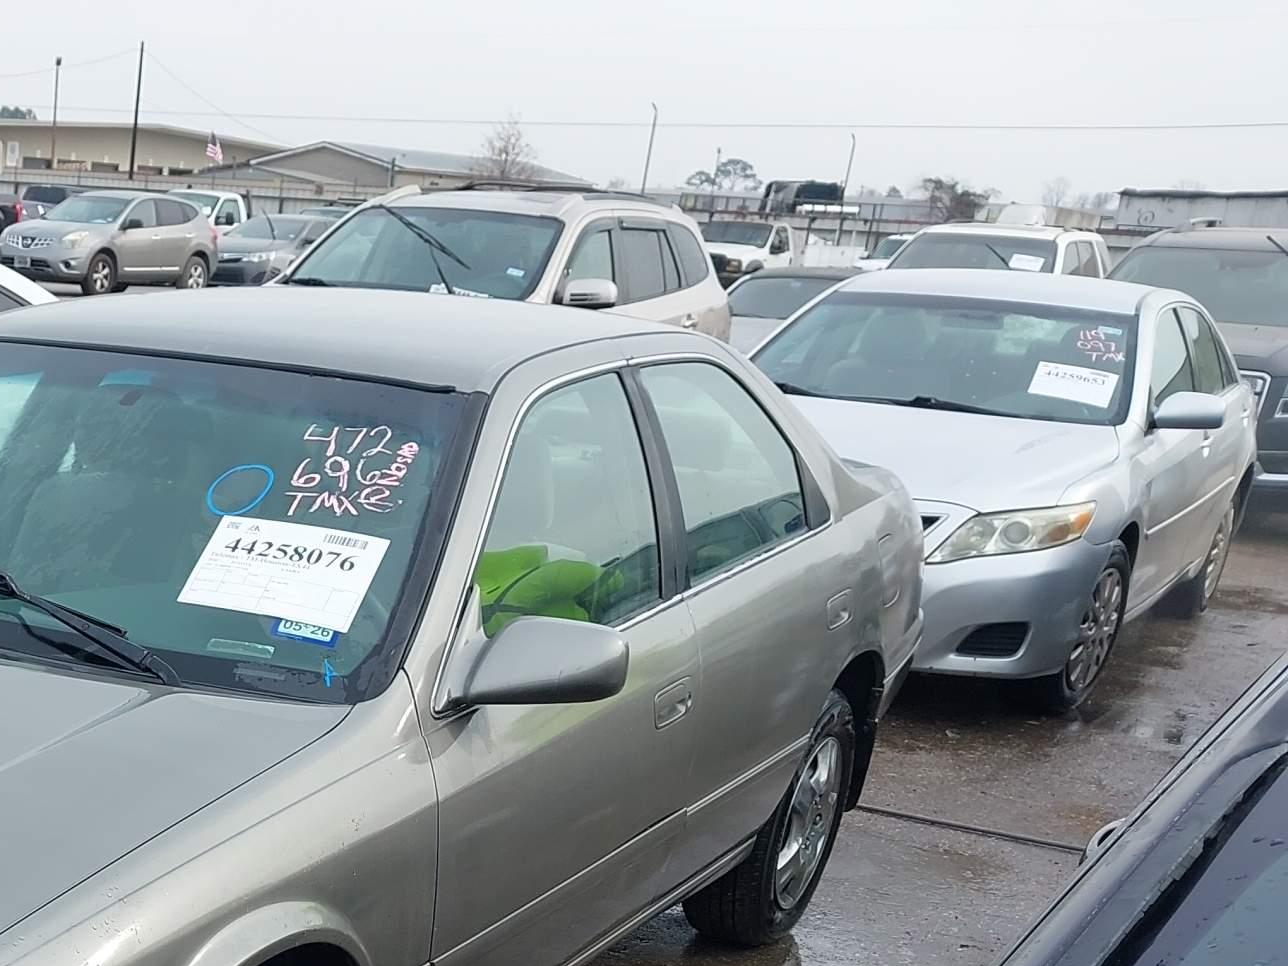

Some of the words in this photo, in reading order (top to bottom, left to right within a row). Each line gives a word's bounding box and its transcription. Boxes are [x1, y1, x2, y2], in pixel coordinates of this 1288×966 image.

[303, 424, 393, 457] 472
[290, 455, 381, 492] 696
[224, 537, 361, 572] 44258076
